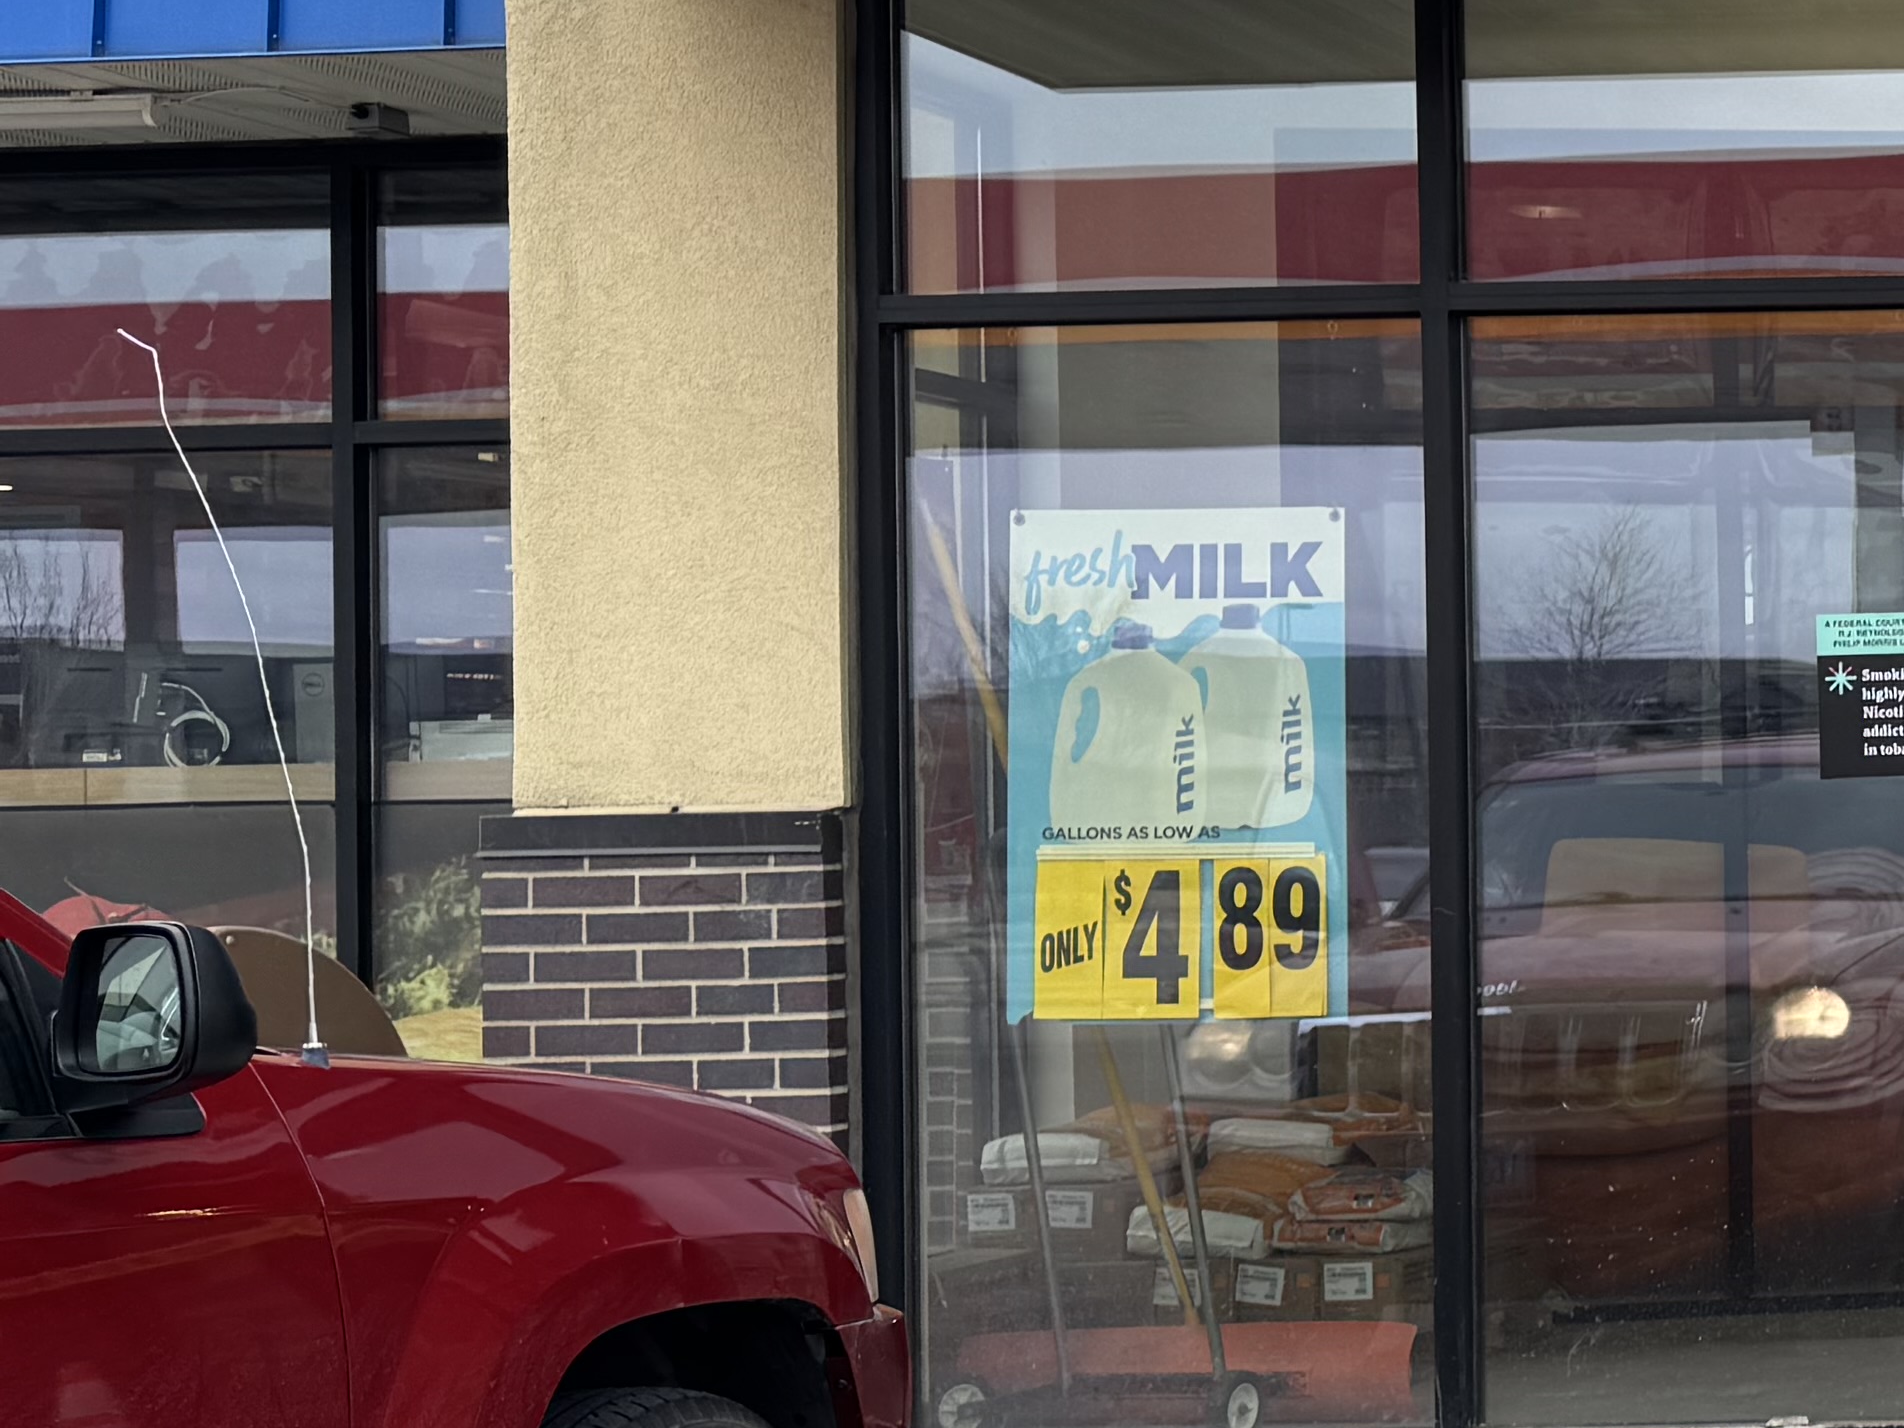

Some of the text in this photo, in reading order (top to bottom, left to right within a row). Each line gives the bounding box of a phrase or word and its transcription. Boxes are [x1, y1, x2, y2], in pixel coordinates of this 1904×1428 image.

[1024, 529, 1323, 616] fresh MILK
[1175, 713, 1196, 815] milk
[1281, 693, 1303, 794] milk
[1863, 742, 1878, 756] in
[1042, 826, 1220, 841] GALLONS AS LOW AS
[1040, 921, 1098, 973] ONLY
